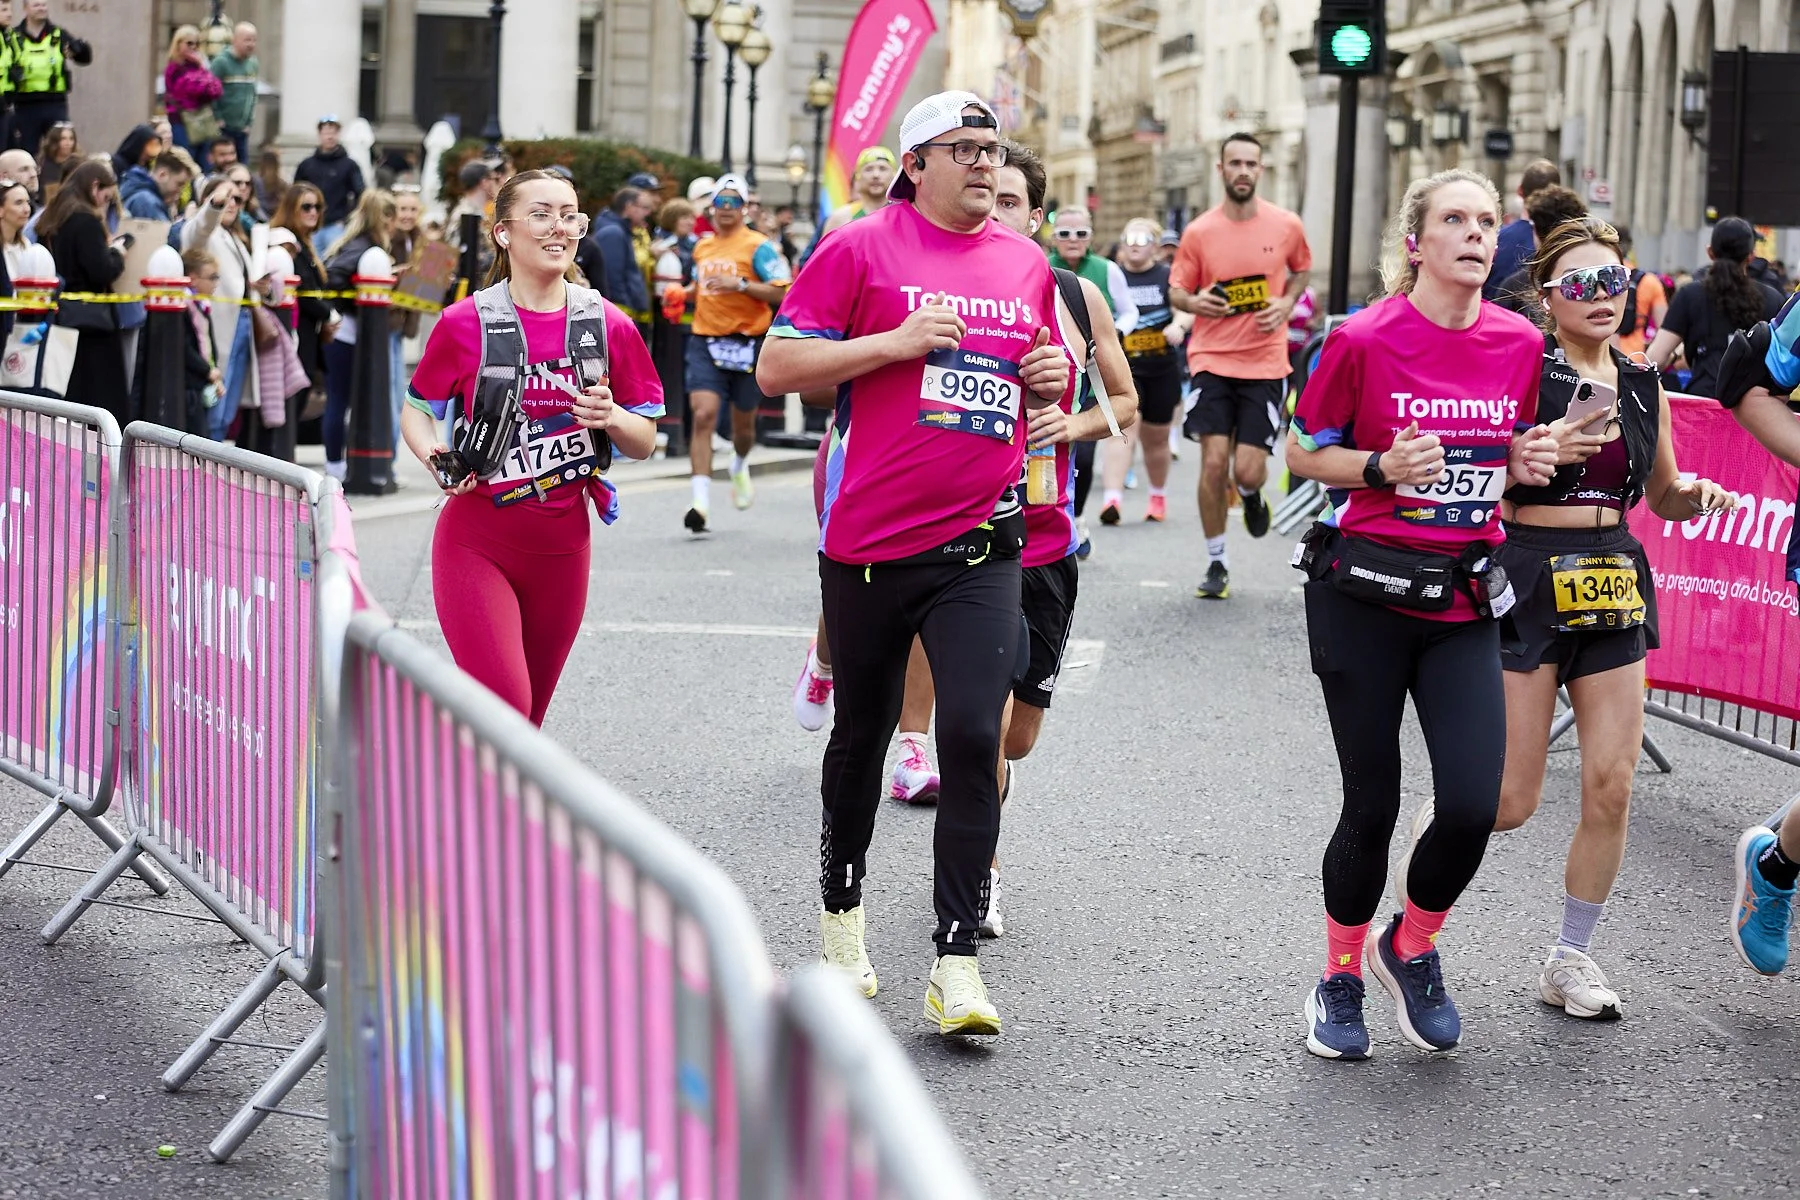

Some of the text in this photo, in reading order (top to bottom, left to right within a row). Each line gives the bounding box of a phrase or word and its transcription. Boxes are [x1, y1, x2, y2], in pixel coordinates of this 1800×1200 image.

[841, 13, 911, 131] Tommy's
[968, 327, 1032, 343] and baby charity
[964, 354, 1000, 369] GARETH
[940, 371, 1012, 411] 9962
[539, 399, 554, 407] and
[1391, 393, 1518, 425] Tommy's
[1415, 428, 1456, 438] regnancy
[1458, 428, 1476, 437] and
[1477, 428, 1496, 438] baby
[1447, 449, 1473, 459] JAYE
[1575, 557, 1603, 567] JENNY
[1350, 565, 1412, 590] LONDON MARATHON
[1384, 585, 1406, 596] EVENTS
[1564, 576, 1634, 602] 13460
[1666, 573, 1729, 601] pregnancy
[1731, 580, 1760, 602] and
[1762, 580, 1799, 616] baby
